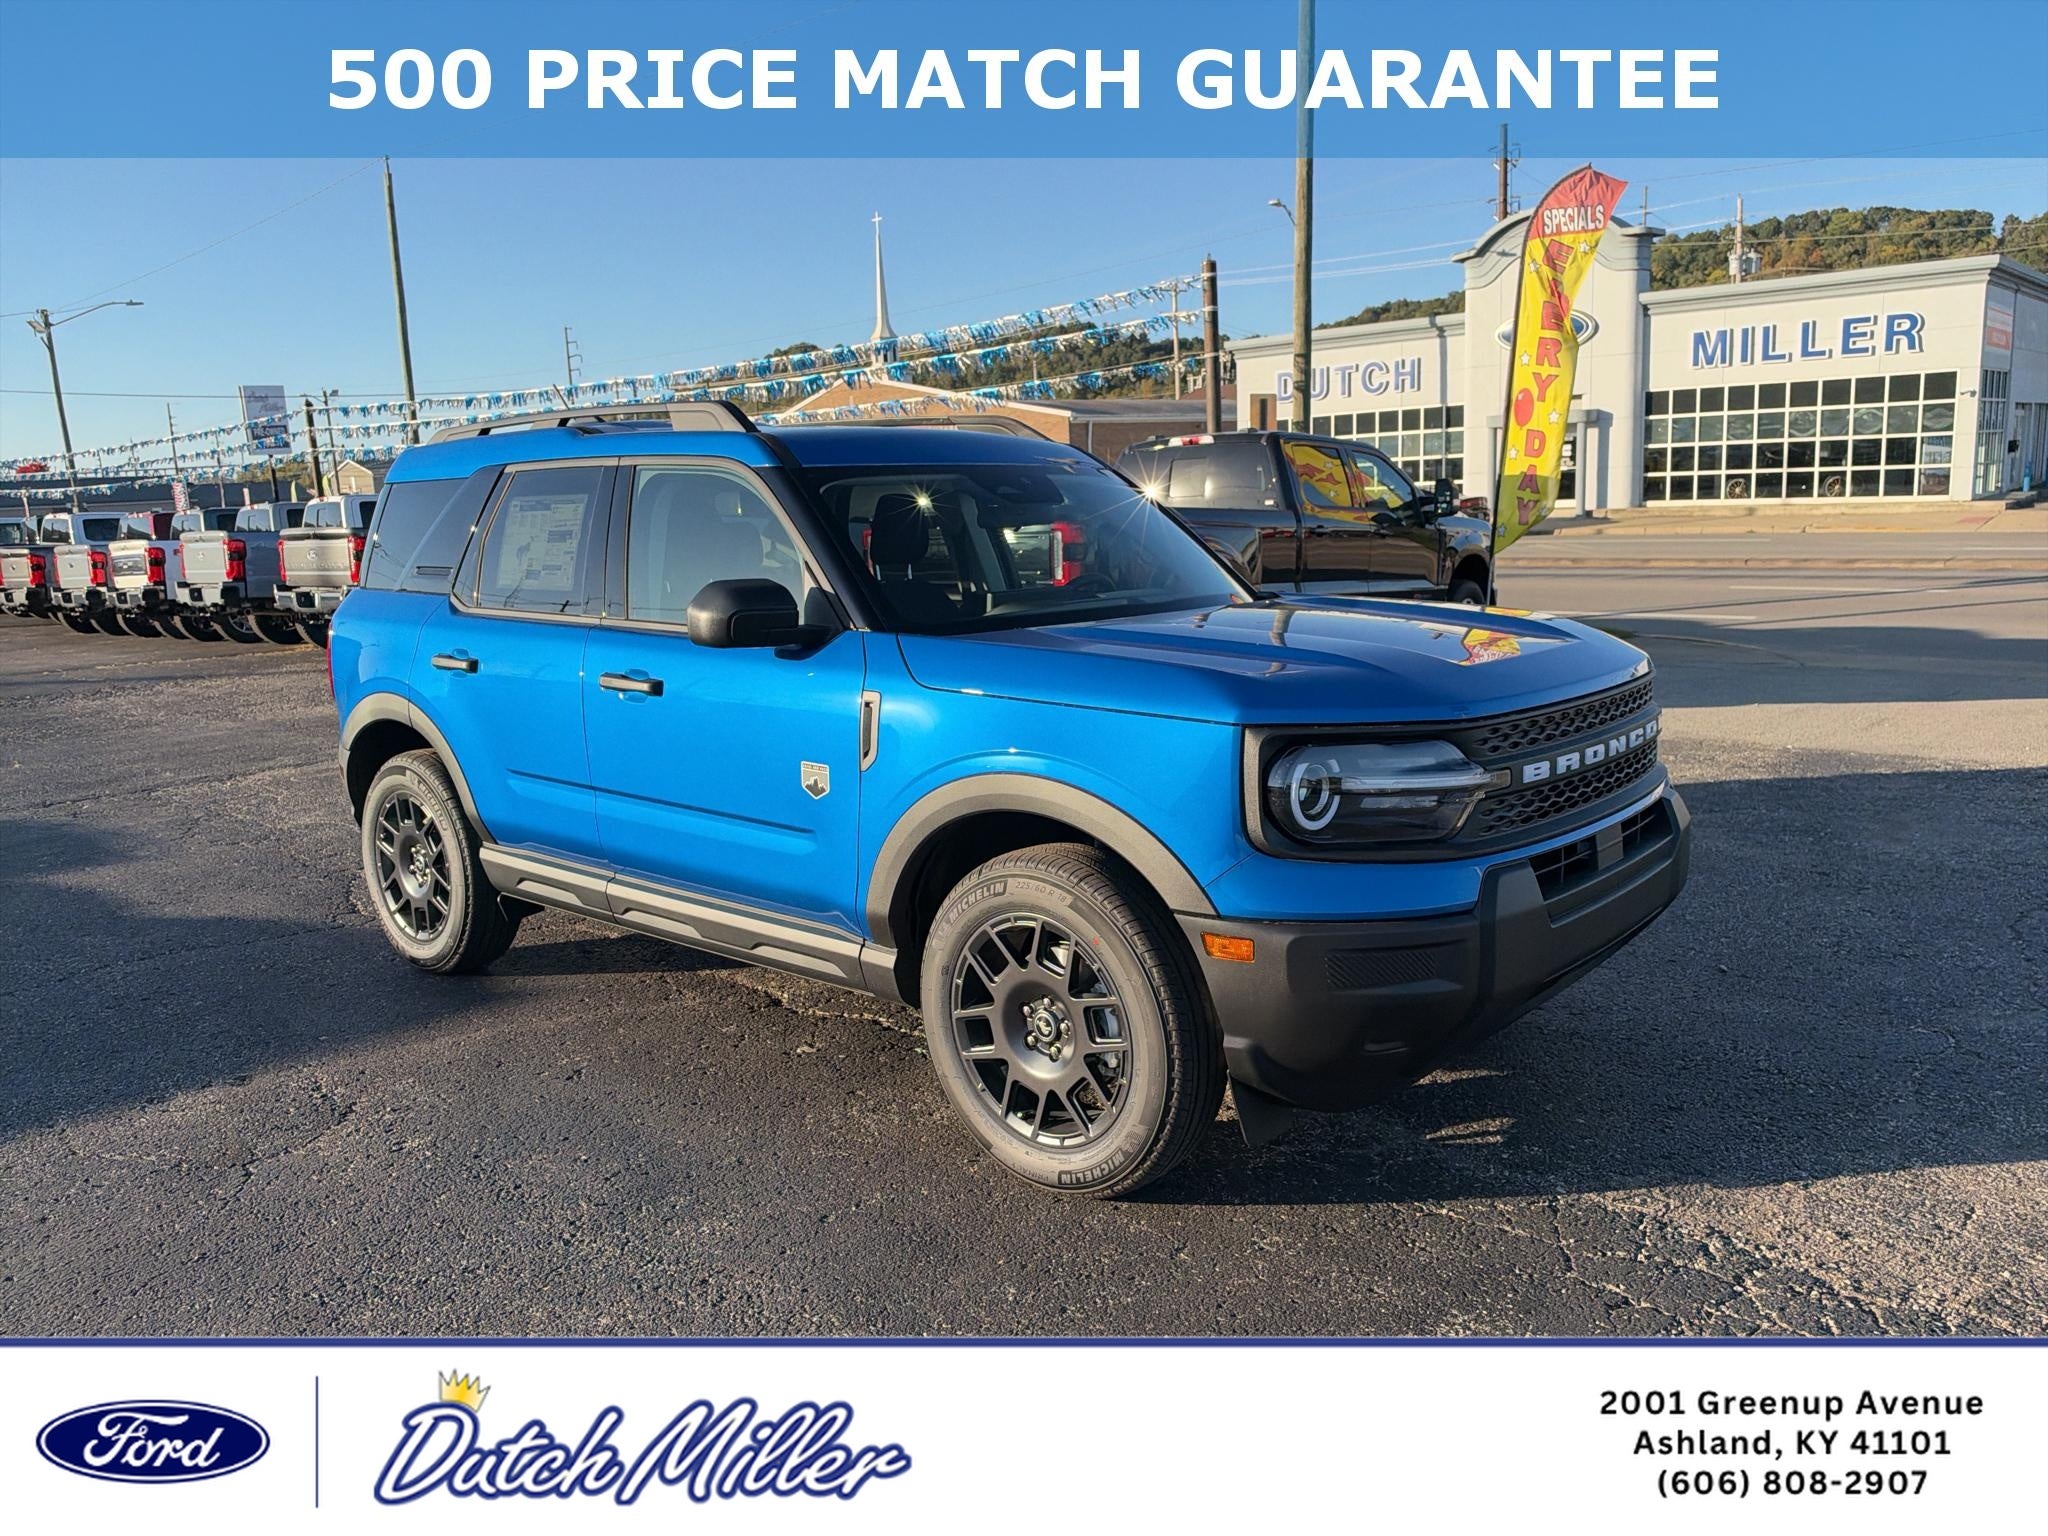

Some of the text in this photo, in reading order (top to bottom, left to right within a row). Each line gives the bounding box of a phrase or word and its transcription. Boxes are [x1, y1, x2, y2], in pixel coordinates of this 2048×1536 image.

[1543, 204, 1605, 235] SPECIALS
[1691, 311, 1925, 370] MILLER
[1516, 429, 1547, 526] DAY
[1522, 720, 1657, 784] BRONCO
[949, 881, 1006, 923] MICHELIN
[1015, 880, 1047, 895] 225/60
[1061, 1152, 1125, 1184] MICHELIN
